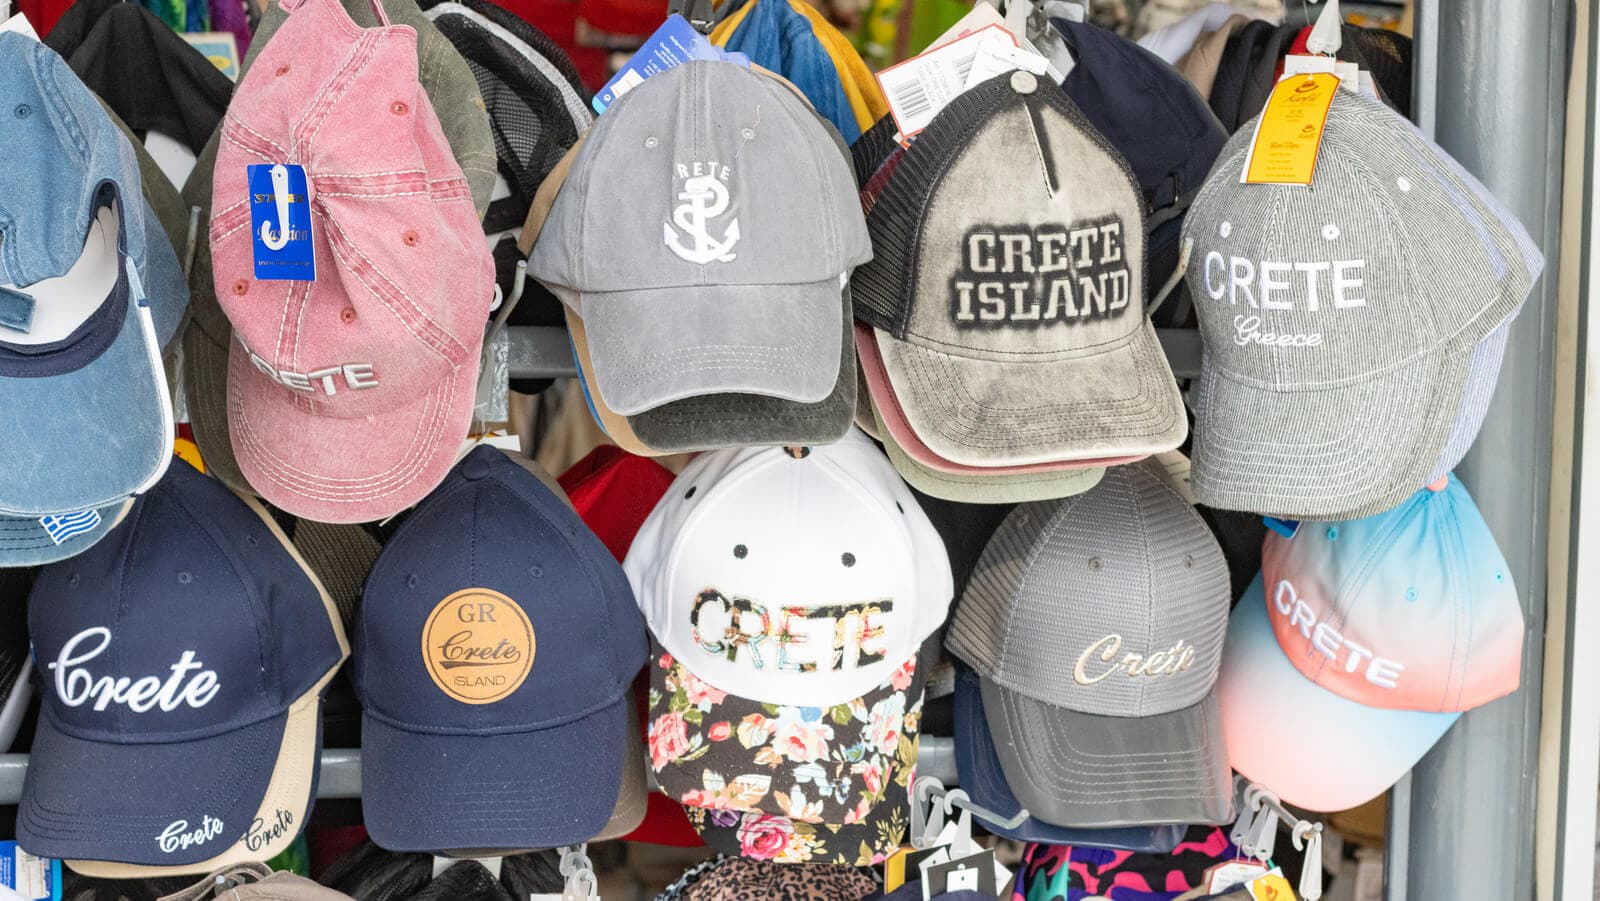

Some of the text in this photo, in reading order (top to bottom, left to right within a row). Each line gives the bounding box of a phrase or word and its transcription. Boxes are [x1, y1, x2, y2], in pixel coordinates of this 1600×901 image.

[675, 161, 731, 181] RETE
[968, 222, 1121, 274] CRETE
[955, 268, 1129, 321] ISLAND
[1204, 250, 1367, 313] CRETE
[1233, 314, 1323, 346] Greece
[457, 602, 497, 623] GR
[690, 587, 894, 673] CRETE
[1275, 580, 1405, 689] CRETE
[438, 630, 520, 661] Crete
[1073, 634, 1196, 685] Crete
[48, 626, 221, 713] Crete
[453, 674, 506, 687] ISLAND
[155, 814, 224, 853] Crete
[240, 809, 293, 852] Crete
